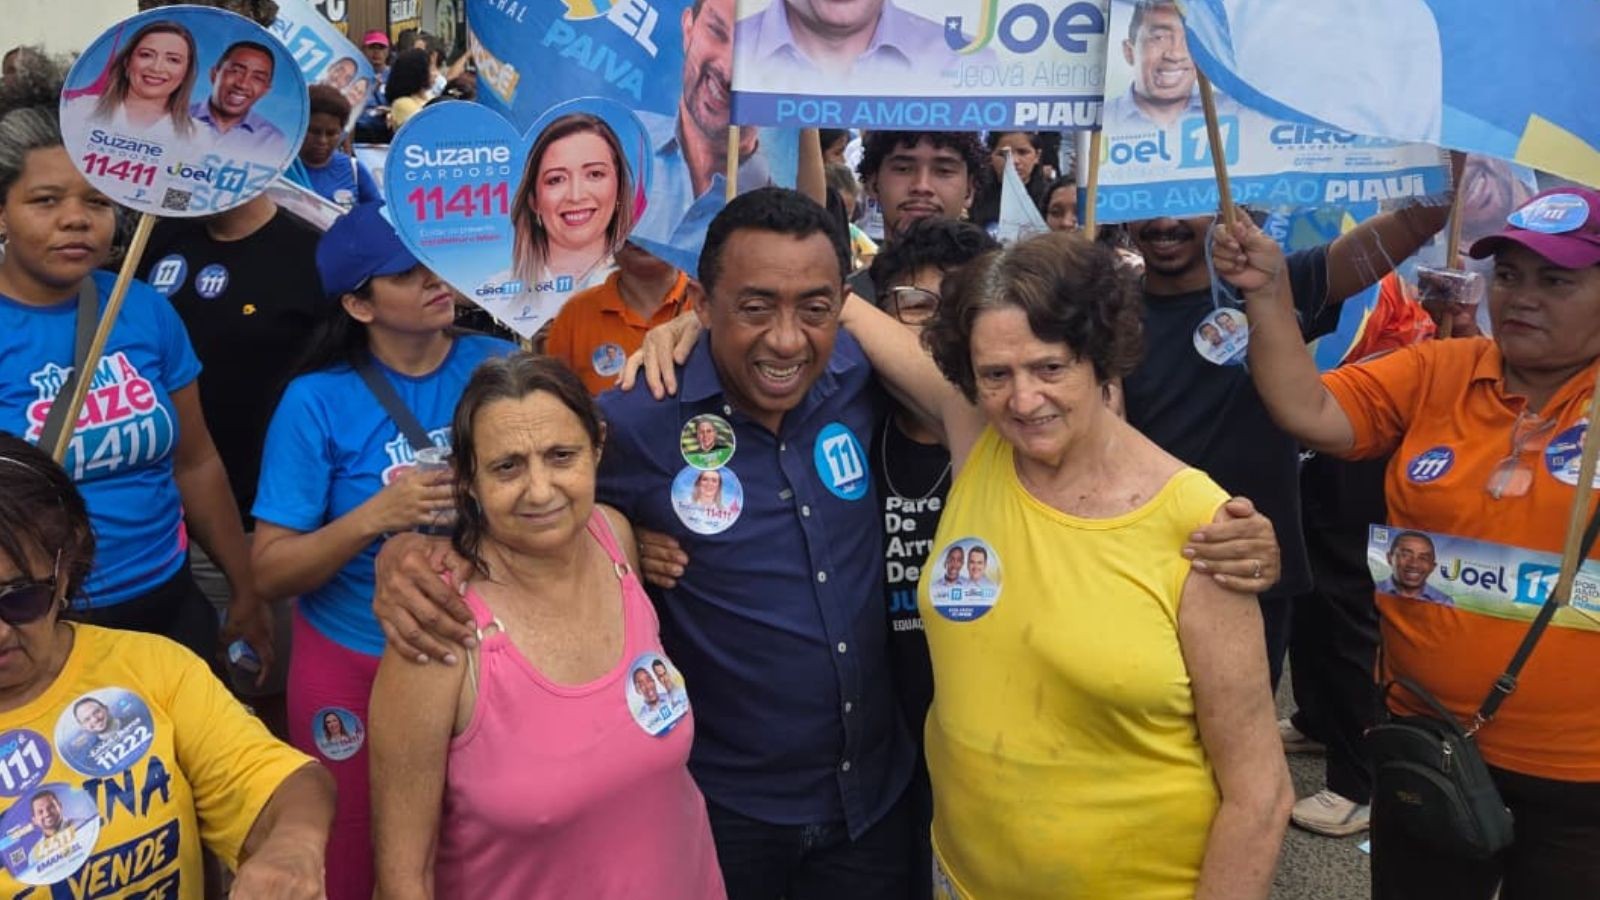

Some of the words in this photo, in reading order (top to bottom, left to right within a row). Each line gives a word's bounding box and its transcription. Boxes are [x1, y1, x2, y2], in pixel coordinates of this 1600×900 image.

[543, 18, 645, 102] PAIVA
[776, 99, 842, 124] POR
[851, 100, 951, 126] AMOR
[958, 102, 1008, 126] AO
[90, 129, 163, 157] Suzane
[404, 144, 511, 169] Suzane
[82, 152, 158, 187] 11411
[167, 161, 214, 184] Joel
[223, 170, 245, 190] 11
[405, 165, 510, 181] CARDOSO
[408, 181, 509, 221] 11411
[1269, 178, 1319, 203] AO
[67, 416, 157, 482] 1411
[827, 437, 859, 479] 11
[1411, 458, 1449, 478] 111
[886, 496, 941, 513] Pare
[885, 513, 917, 533] De
[1440, 558, 1507, 593] Joel
[96, 725, 153, 771] 11222
[0, 740, 44, 790] 111
[68, 829, 170, 900] VENDE
